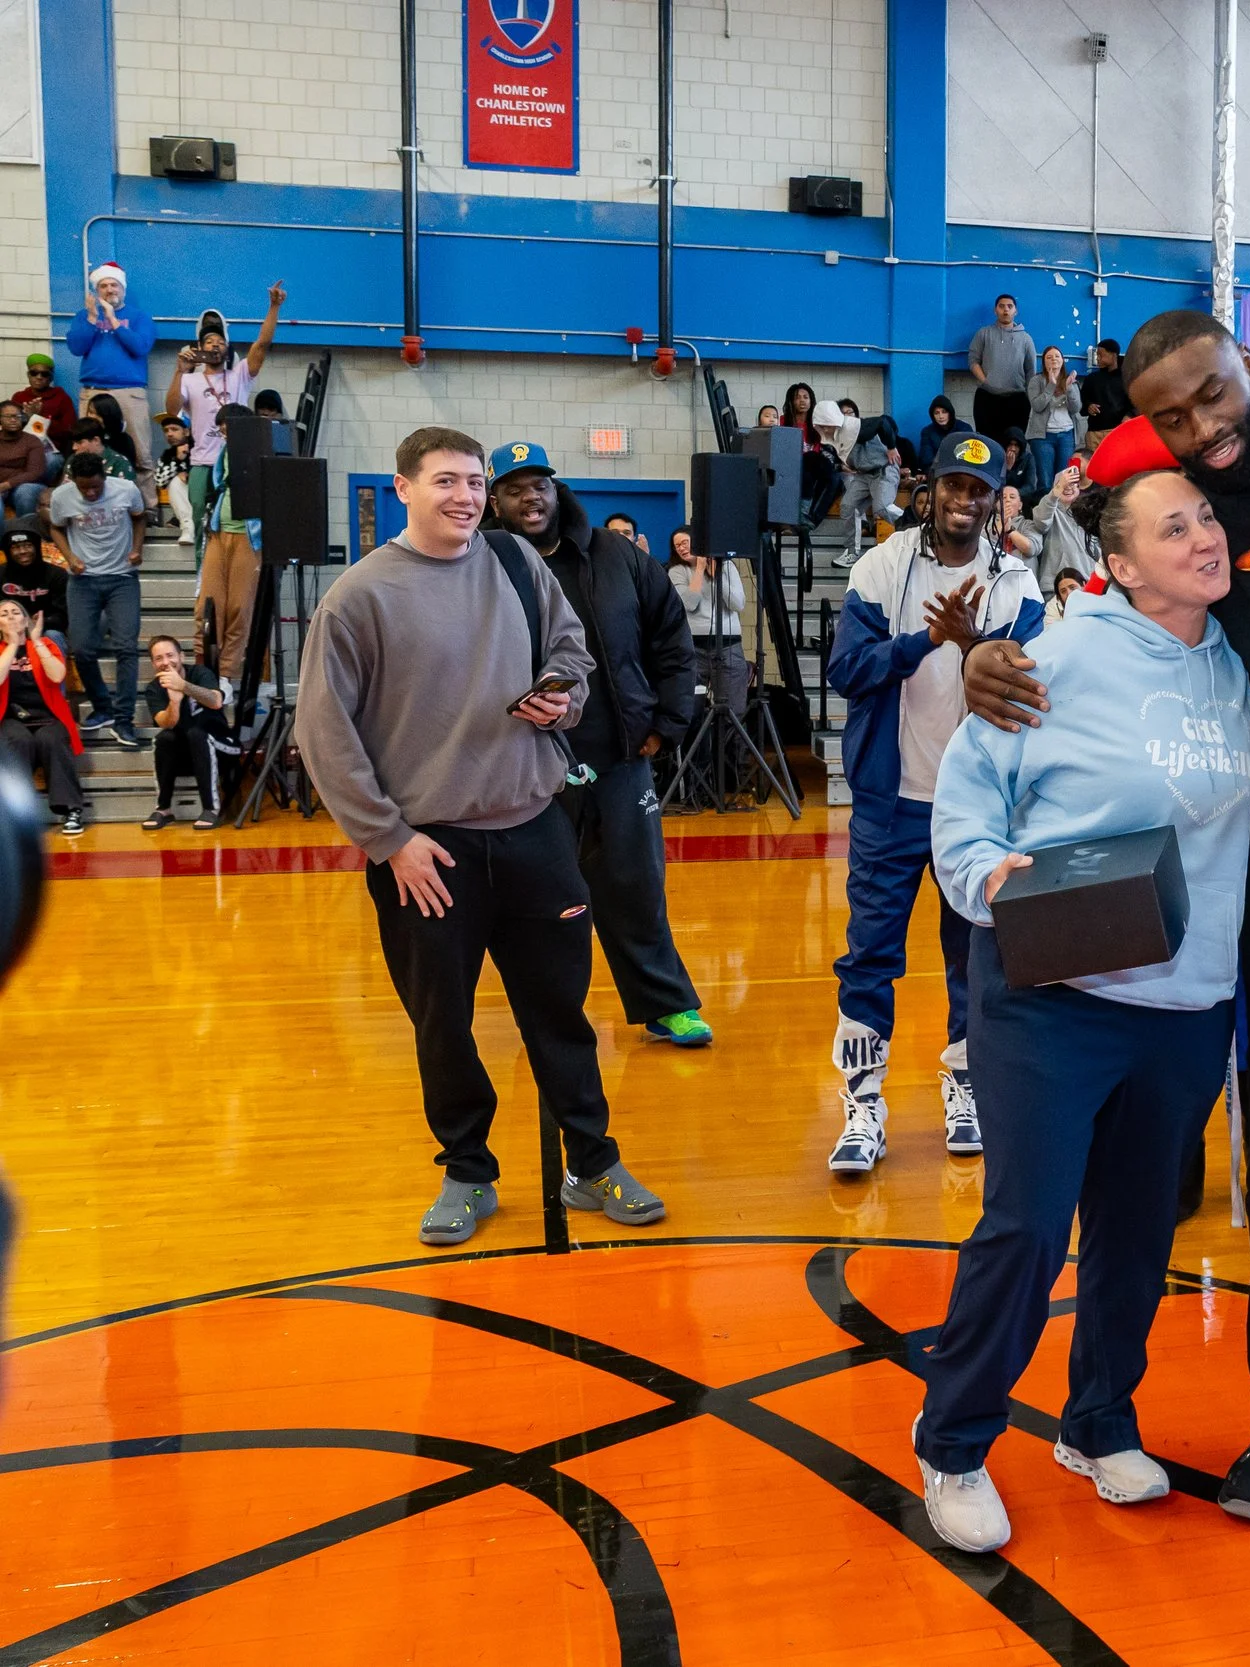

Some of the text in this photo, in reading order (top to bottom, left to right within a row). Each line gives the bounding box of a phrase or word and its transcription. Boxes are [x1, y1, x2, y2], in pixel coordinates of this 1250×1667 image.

[493, 84, 548, 97] HOME OF
[476, 97, 565, 113] CHARLESTOWN
[490, 114, 552, 128] ATHLETICS
[1182, 716, 1225, 745] CHS
